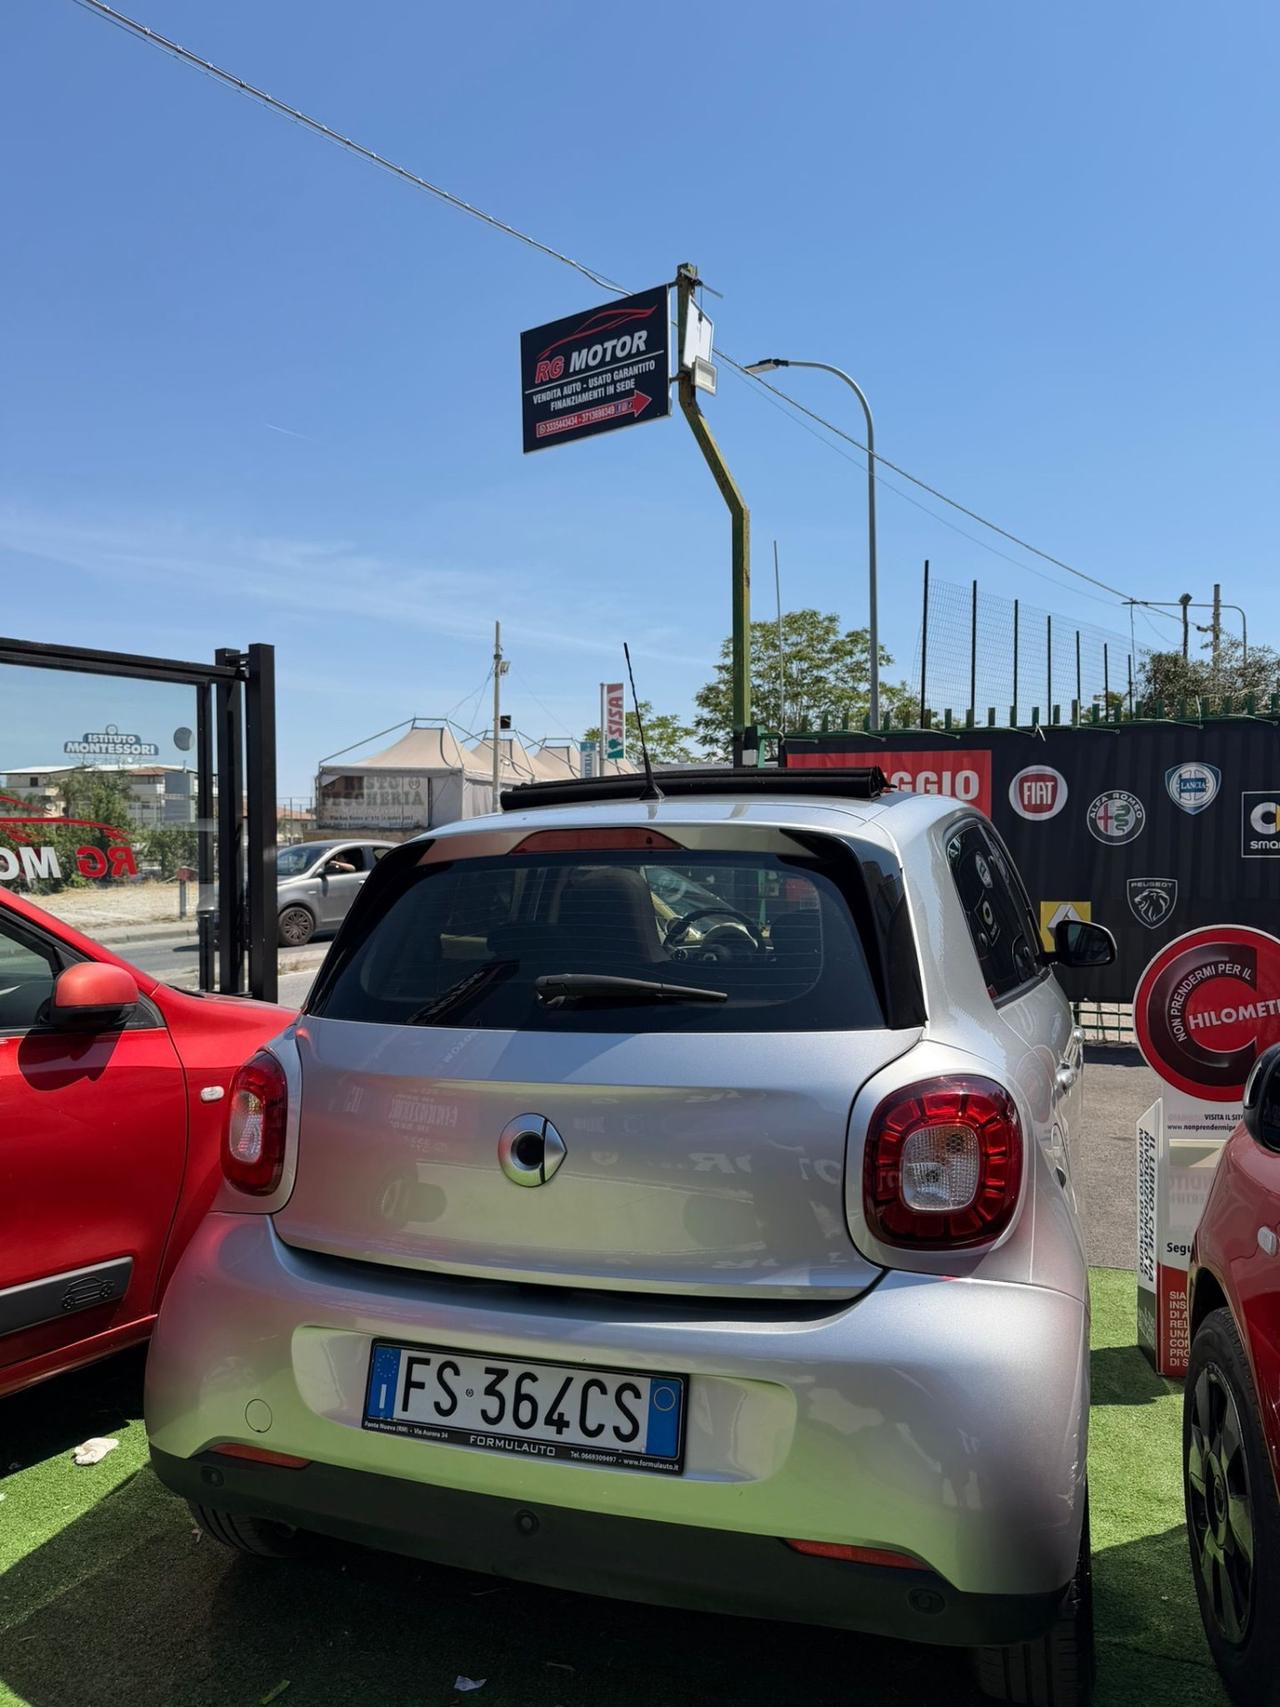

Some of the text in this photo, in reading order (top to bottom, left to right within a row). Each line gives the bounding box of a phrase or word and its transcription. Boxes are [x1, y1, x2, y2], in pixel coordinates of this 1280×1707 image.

[535, 330, 647, 384] RG MOTOR
[532, 388, 561, 405] VENDITA
[563, 382, 581, 396] AUTO
[588, 373, 611, 388] USATO
[613, 360, 656, 380] GARANTITO
[550, 379, 635, 412] FINANZIAMENTI IN SEDE
[608, 696, 623, 738] SISA
[66, 742, 155, 755] MONTESSORI
[87, 734, 136, 744] ISTITUTO
[883, 770, 979, 800] GGIO
[1023, 781, 1055, 805] FIAT
[1180, 781, 1206, 790] LANCIA
[321, 791, 424, 806] PESCHERIA
[1090, 793, 1143, 819] ALFA ROMEO
[1171, 963, 1252, 1042] NON PRENDERMI PER IL
[1149, 1136, 1156, 1149] IL
[1144, 1263, 1149, 1276] IL
[1148, 1256, 1154, 1282] HA
[1170, 1310, 1179, 1318] DI
[1170, 1358, 1179, 1366] DI
[401, 1355, 642, 1443] FS 364CS
[413, 1427, 422, 1435] Via
[470, 1435, 556, 1456] FORMULAUTO
[623, 1459, 679, 1471] www.formulauto.it
